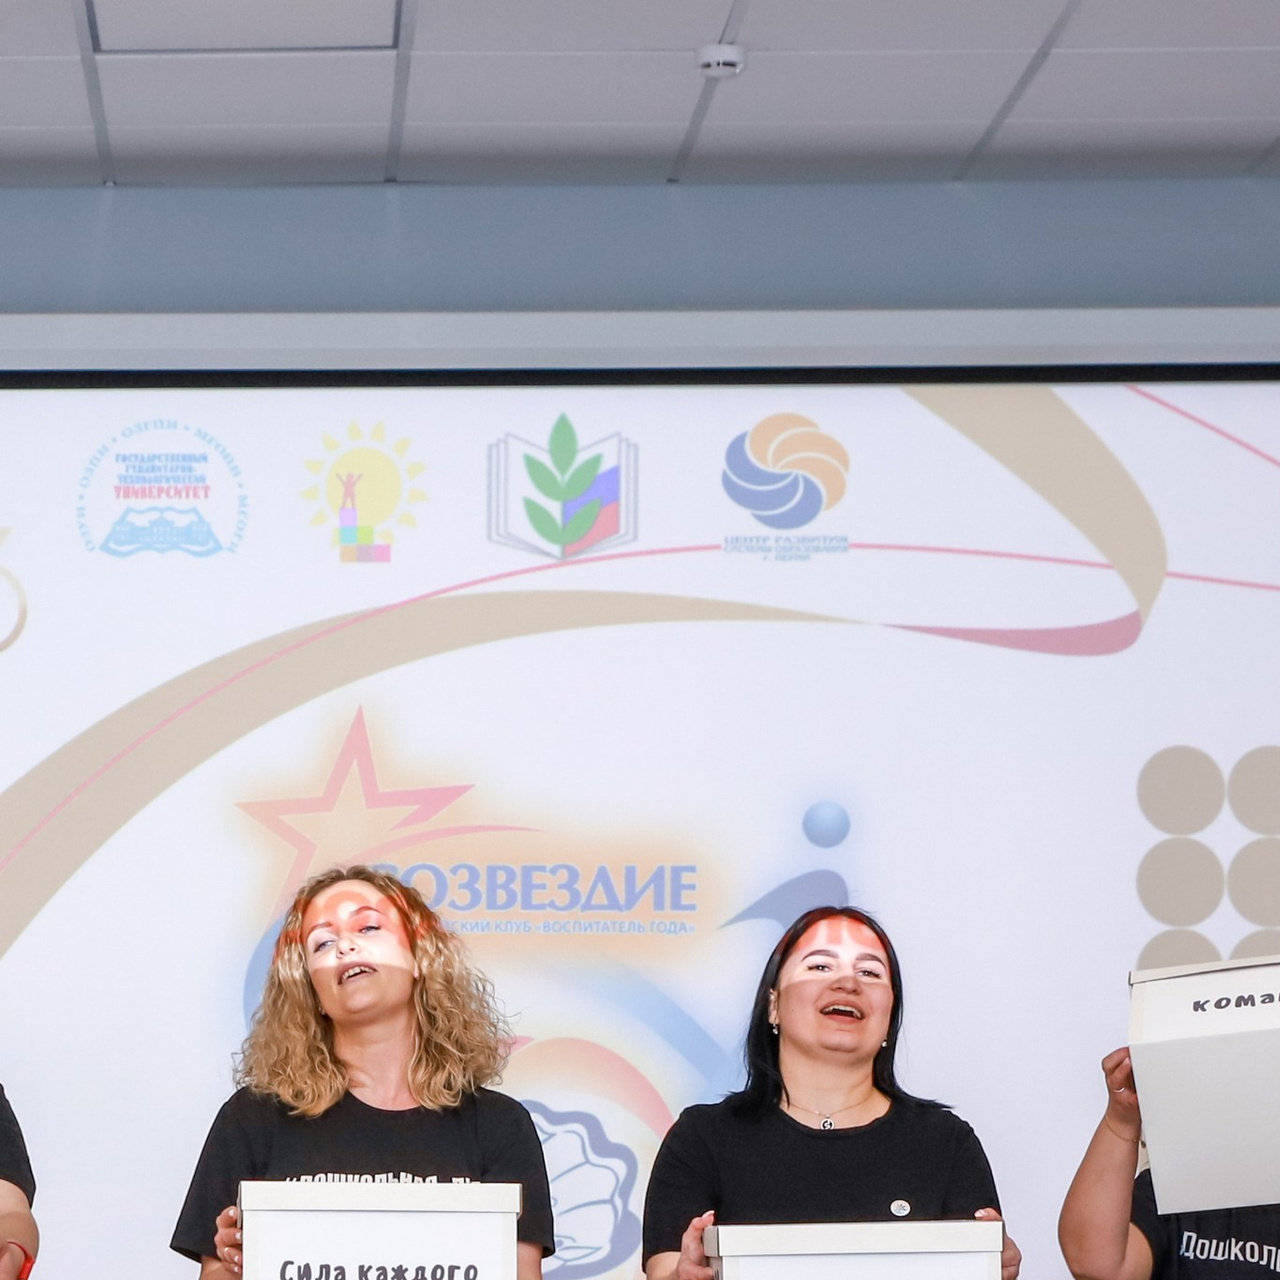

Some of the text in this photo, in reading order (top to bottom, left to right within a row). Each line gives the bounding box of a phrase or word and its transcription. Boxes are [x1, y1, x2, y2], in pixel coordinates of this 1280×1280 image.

[114, 485, 210, 499] УНИВЕРСИТЕТ
[774, 535, 849, 545] РАЗВИТИЯ
[373, 862, 698, 912] ОЗВЕЗДИЕ
[494, 920, 532, 934] КЛУБ
[536, 920, 646, 935] «ВОСПИТАТЕЛЬ
[649, 920, 696, 937] ГОДА»
[1192, 992, 1280, 1012] кома
[1180, 1230, 1280, 1273] Дошкол
